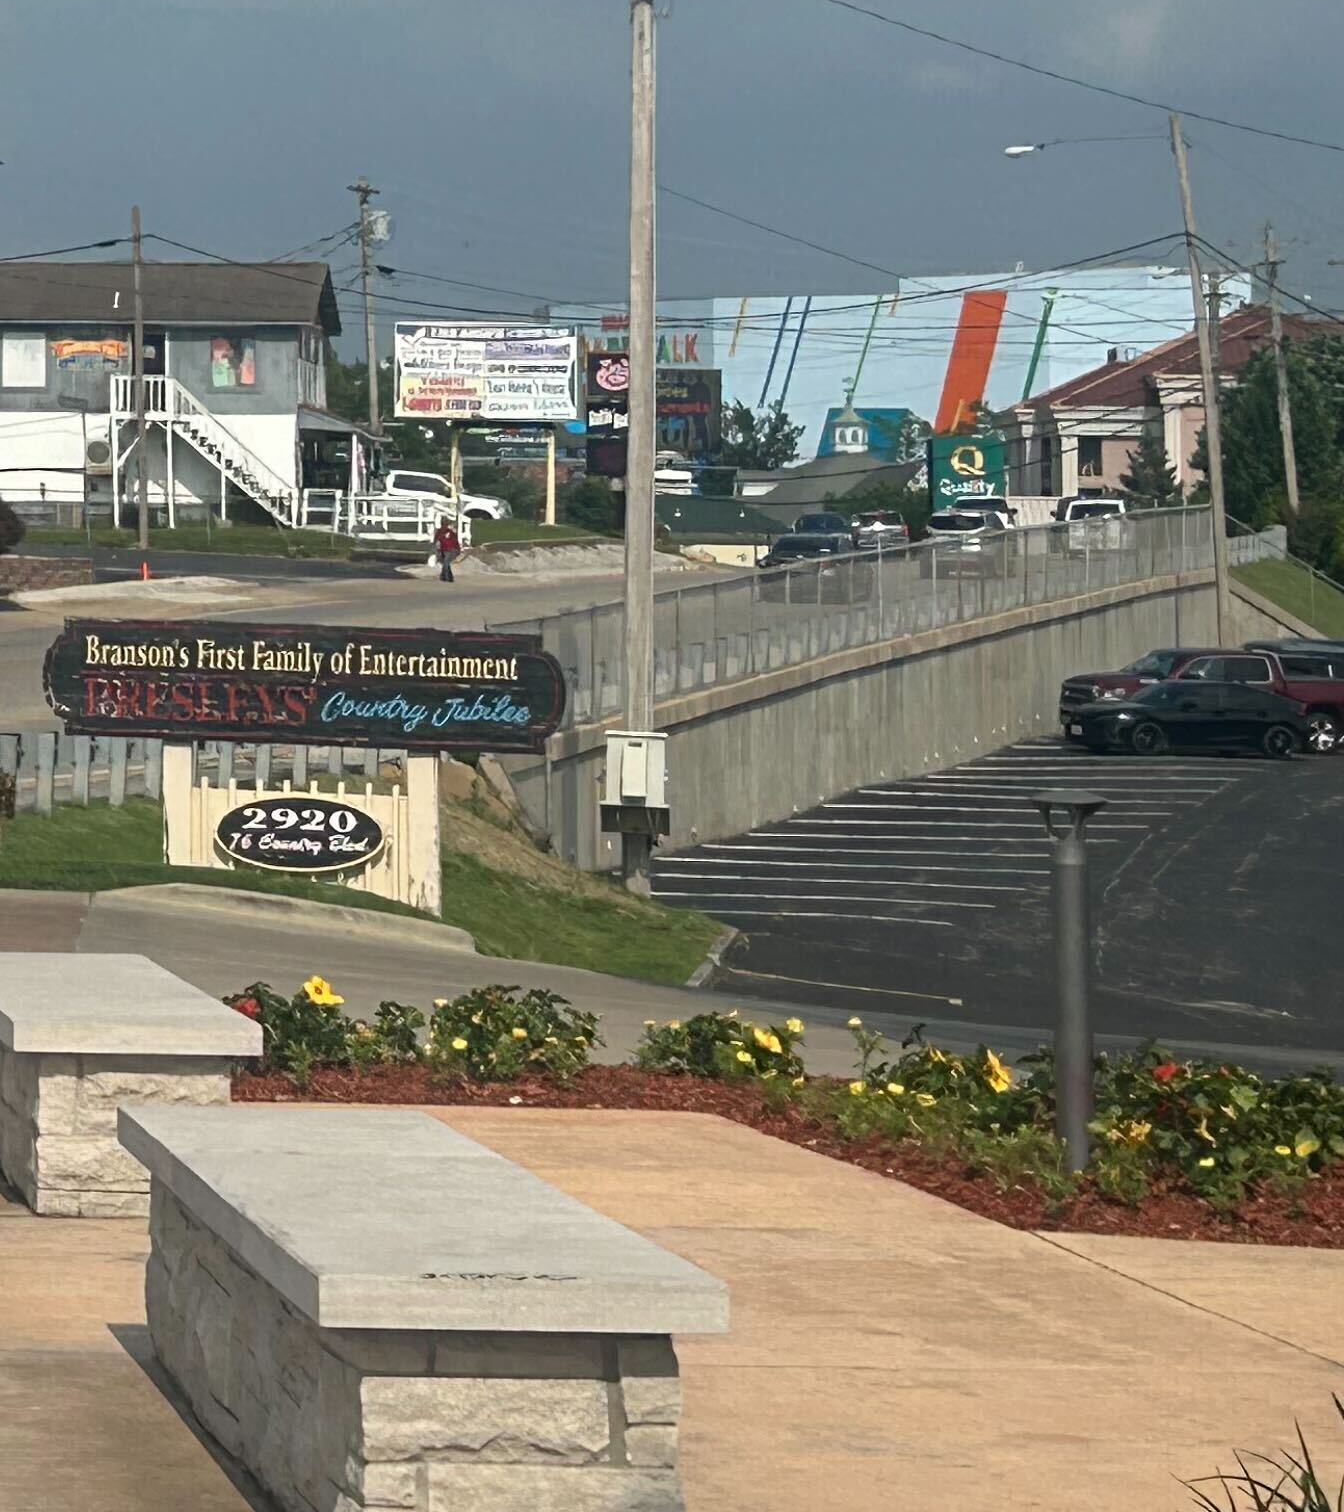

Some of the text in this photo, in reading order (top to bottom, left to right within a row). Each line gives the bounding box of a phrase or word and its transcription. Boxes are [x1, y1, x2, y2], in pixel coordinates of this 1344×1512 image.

[85, 634, 519, 684] Branson's First Family of Entertainment
[320, 691, 428, 733] Country
[431, 694, 531, 727] Jubilee
[241, 807, 359, 833] 2920
[229, 833, 252, 850] 76
